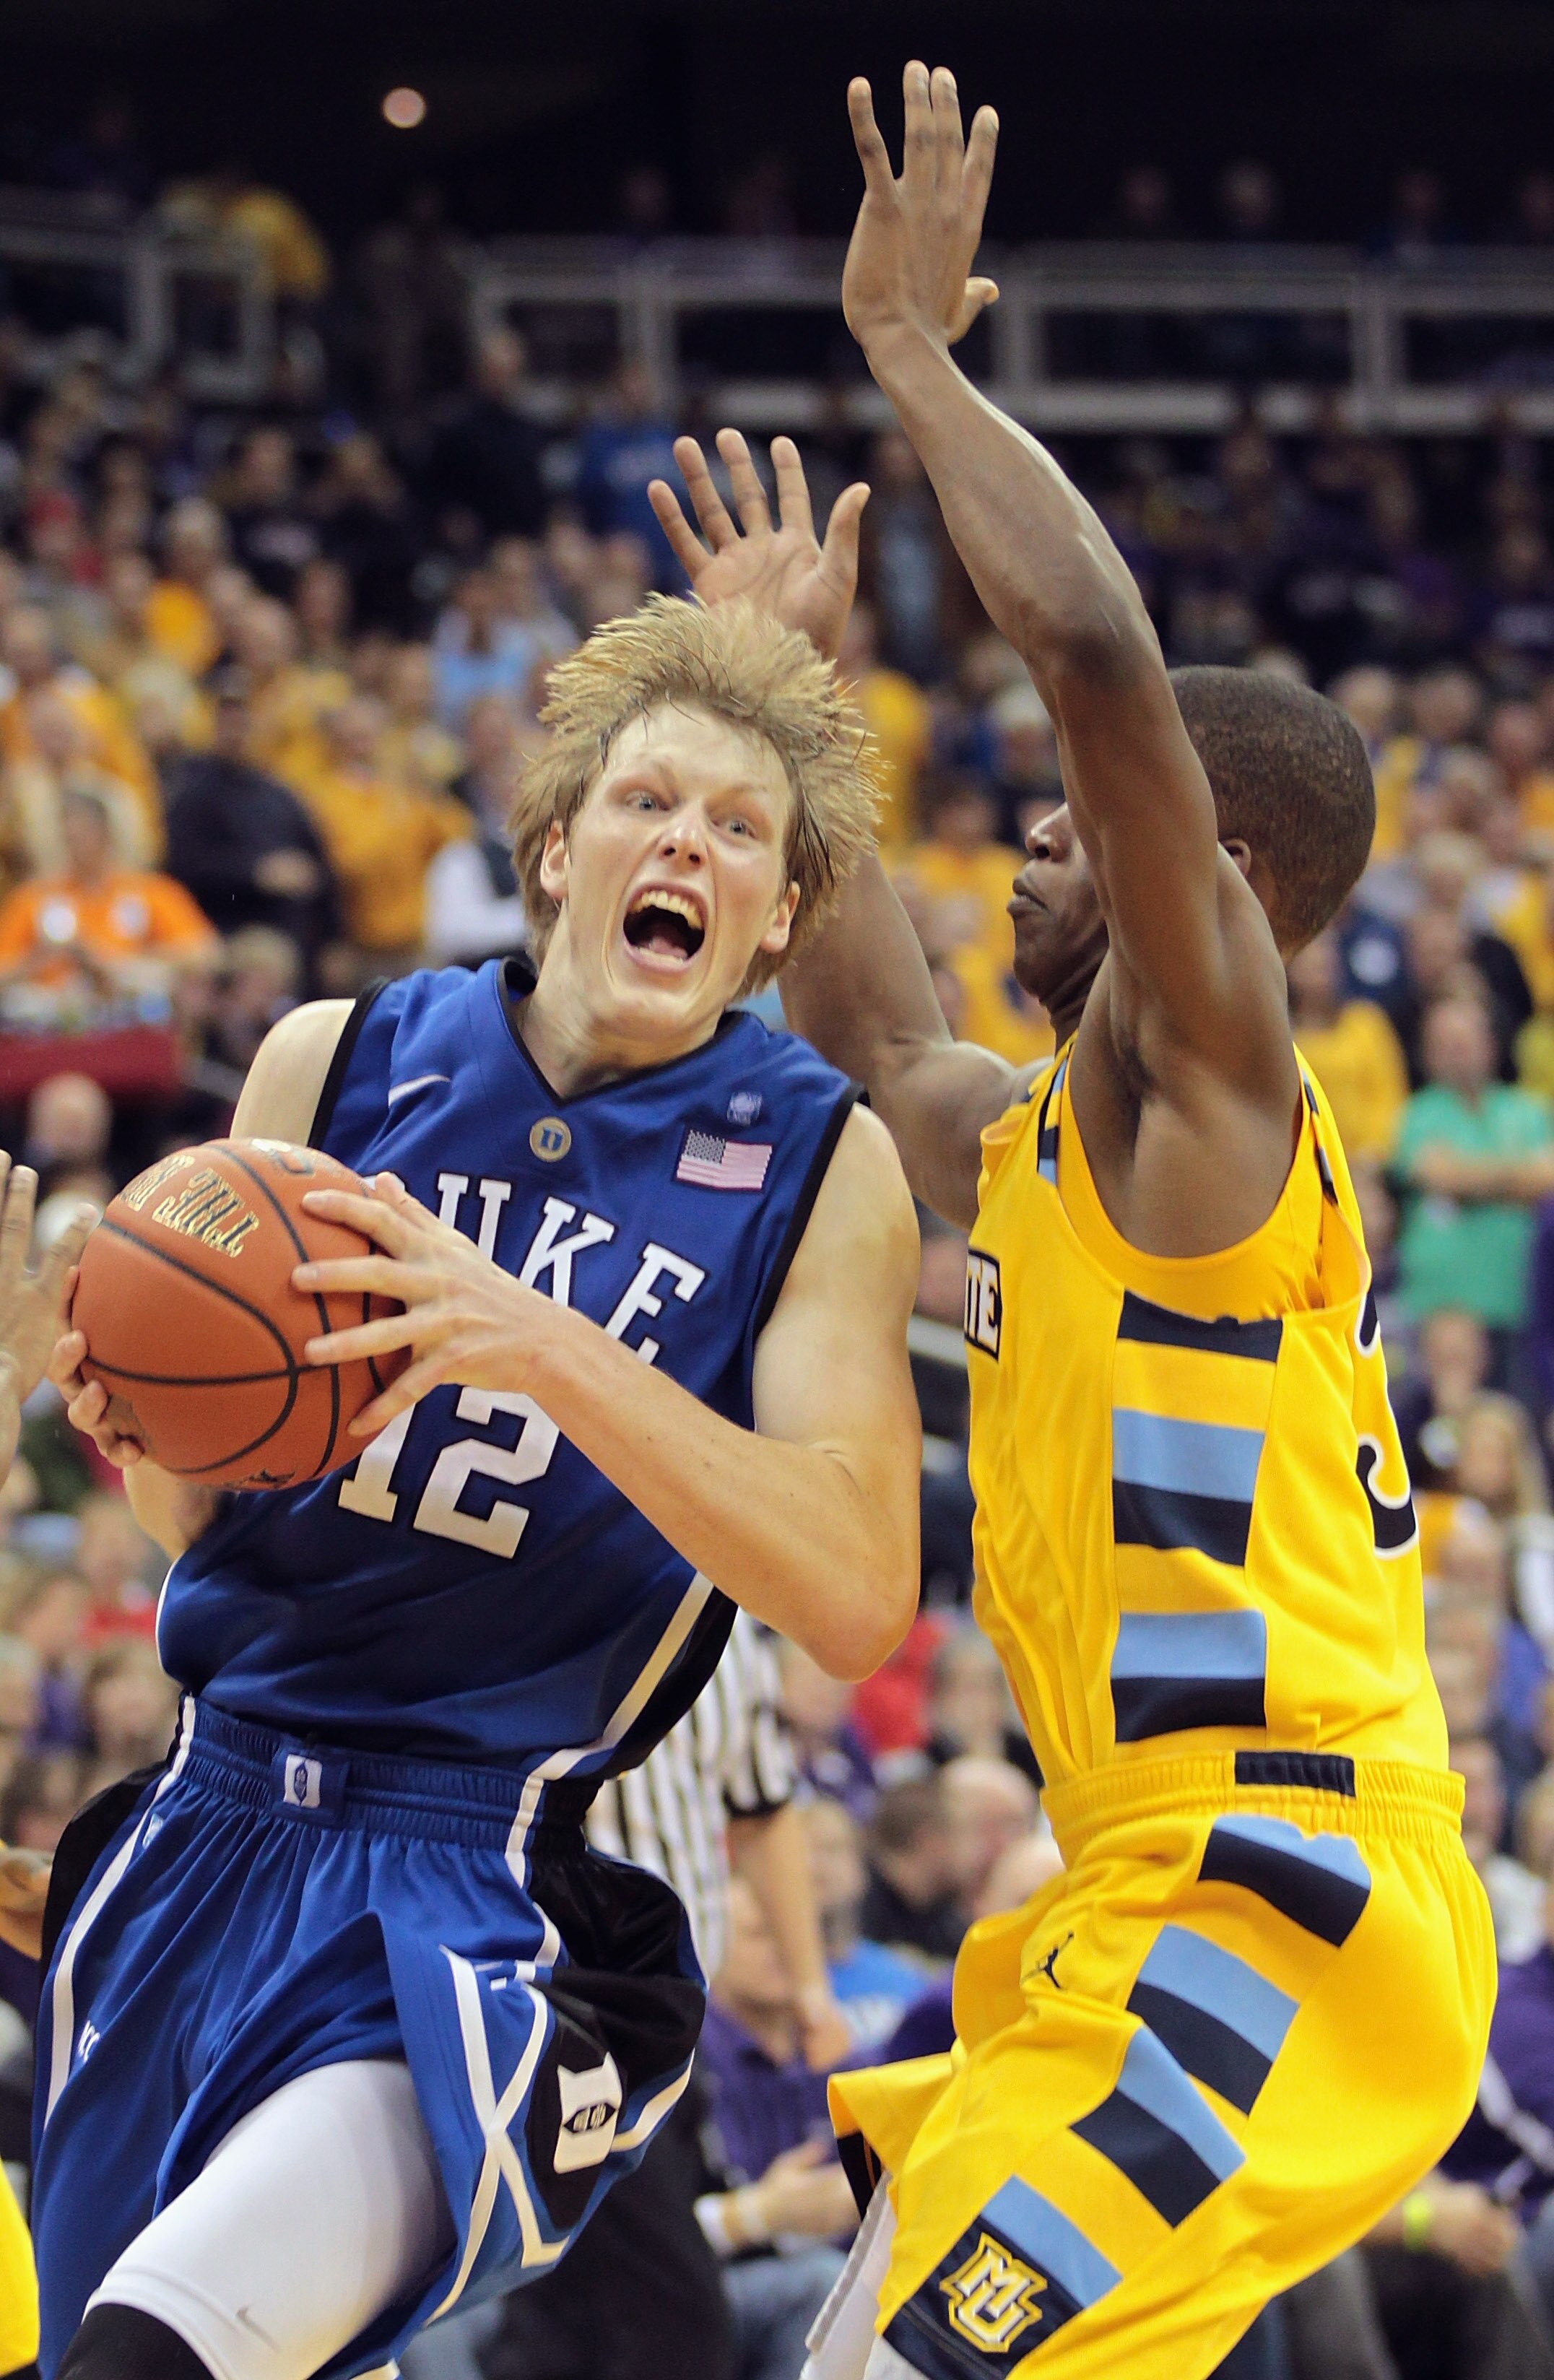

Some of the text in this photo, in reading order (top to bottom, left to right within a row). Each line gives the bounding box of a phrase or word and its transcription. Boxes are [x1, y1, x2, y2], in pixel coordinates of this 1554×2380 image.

[363, 1172, 706, 1365] UKE
[339, 1385, 560, 1559] 12
[950, 2241, 1038, 2348] MU
